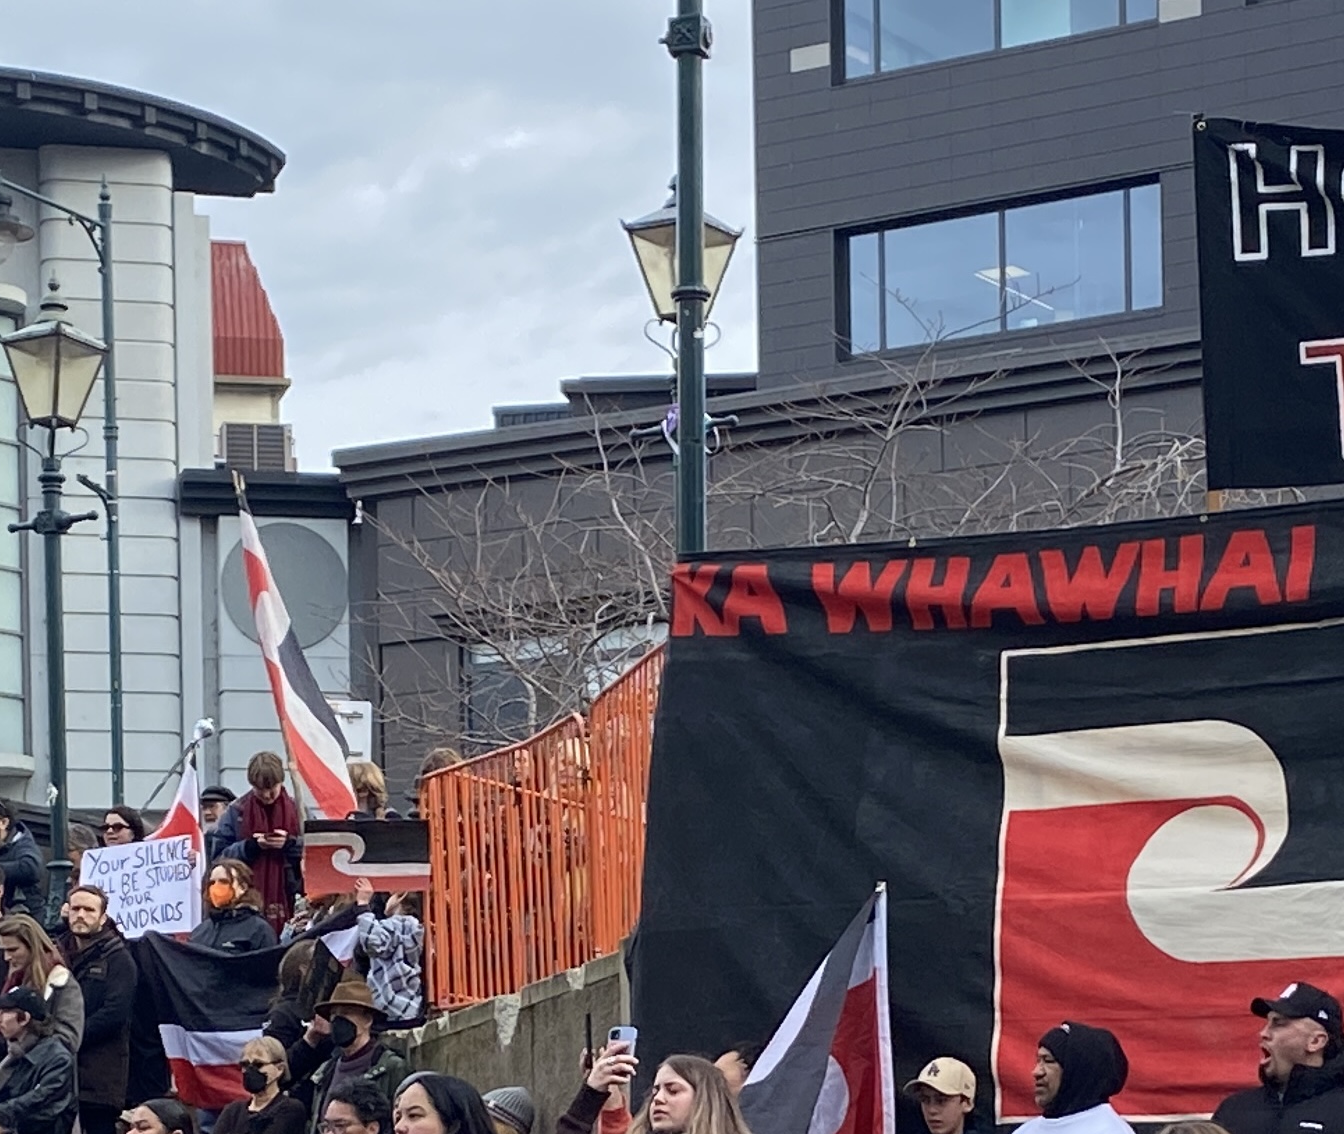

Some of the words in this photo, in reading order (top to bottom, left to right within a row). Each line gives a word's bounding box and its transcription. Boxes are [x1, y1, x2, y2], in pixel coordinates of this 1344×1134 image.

[670, 562, 787, 636] KA
[811, 524, 1316, 633] WHAWHAI
[132, 837, 190, 869] SILENCE
[121, 871, 140, 897] BE
[145, 863, 192, 889] STUDIED
[116, 901, 183, 931] ANDKIDS
[119, 891, 154, 909] YOUR
